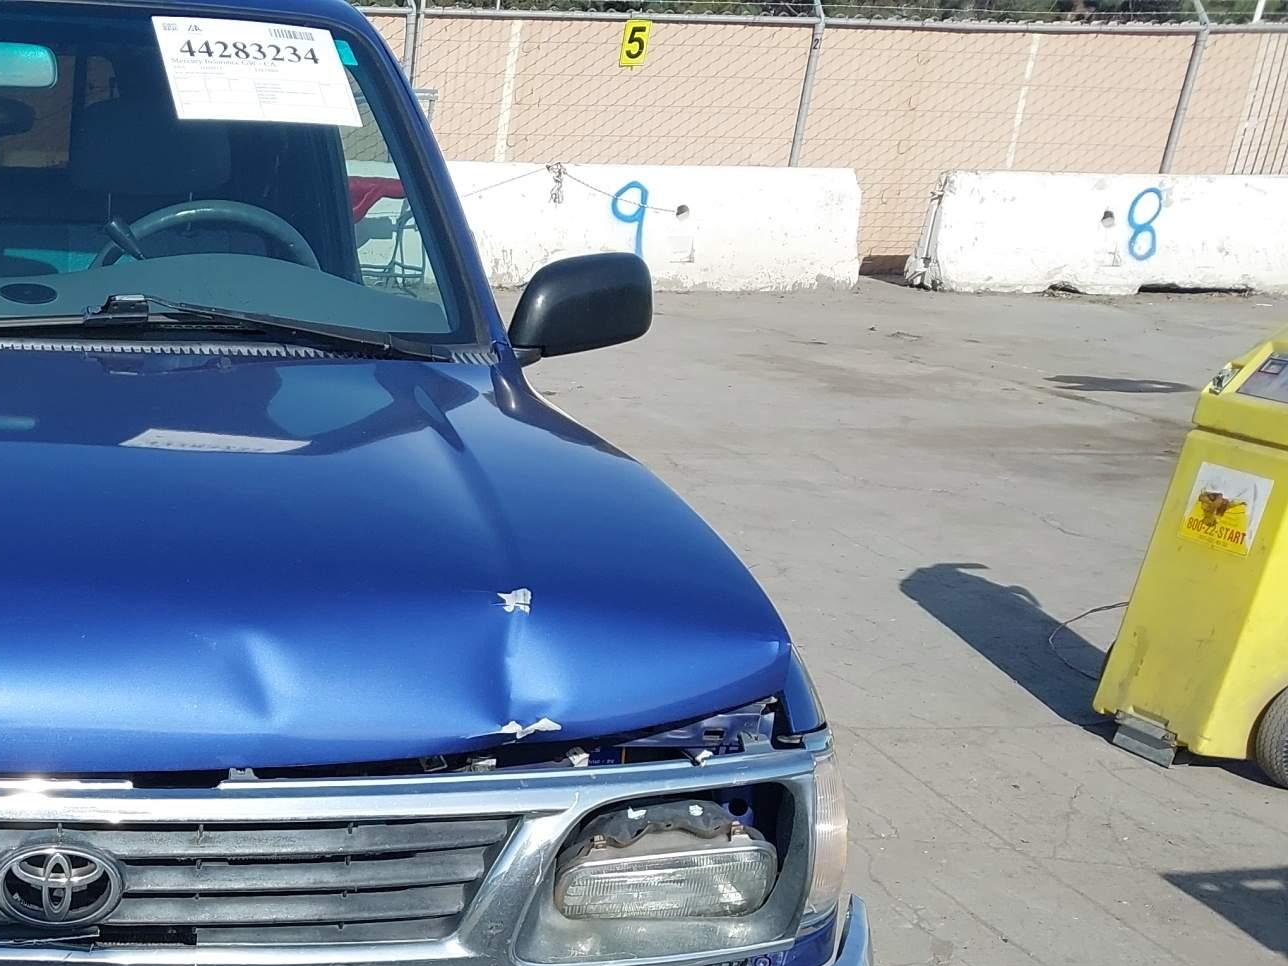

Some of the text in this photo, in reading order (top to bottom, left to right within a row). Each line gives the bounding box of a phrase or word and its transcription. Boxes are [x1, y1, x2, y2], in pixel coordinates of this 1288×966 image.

[180, 39, 320, 65] 44283234
[625, 26, 647, 59] 5
[611, 180, 649, 257] 9
[1128, 187, 1163, 261] 8
